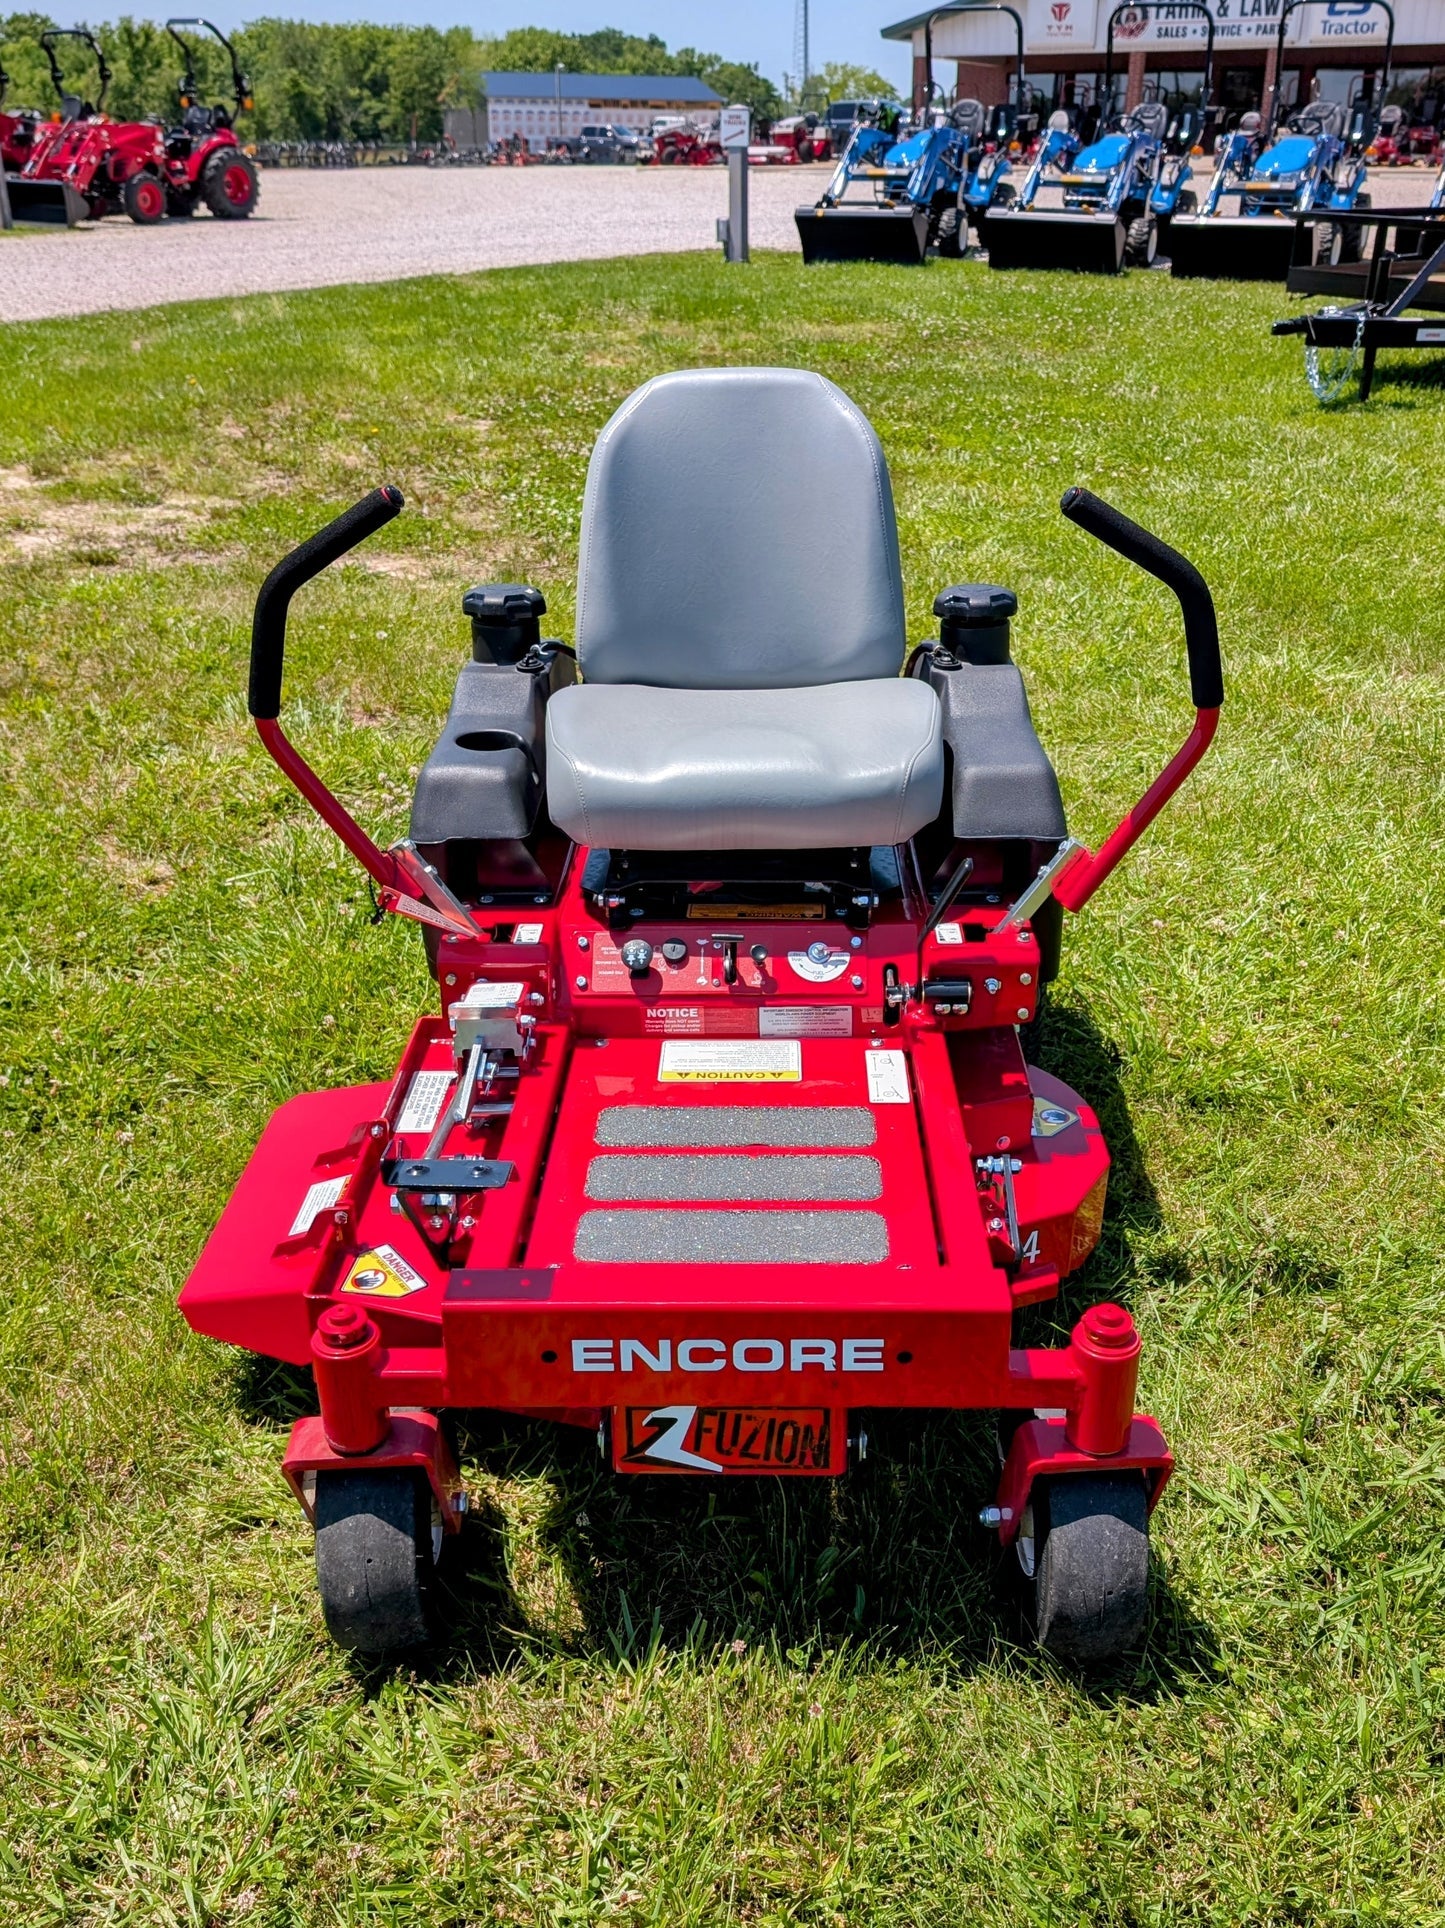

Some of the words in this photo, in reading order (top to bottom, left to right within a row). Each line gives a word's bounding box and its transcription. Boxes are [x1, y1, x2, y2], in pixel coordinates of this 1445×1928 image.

[1217, 0, 1229, 17] &
[1156, 26, 1187, 38] SALES
[1200, 24, 1243, 37] SRVICE
[1321, 20, 1378, 35] Tractor
[646, 1008, 698, 1018] NOTICE
[382, 1252, 415, 1282] DANGER
[571, 1338, 885, 1372] ENCORE
[693, 1408, 830, 1469] FUZION
